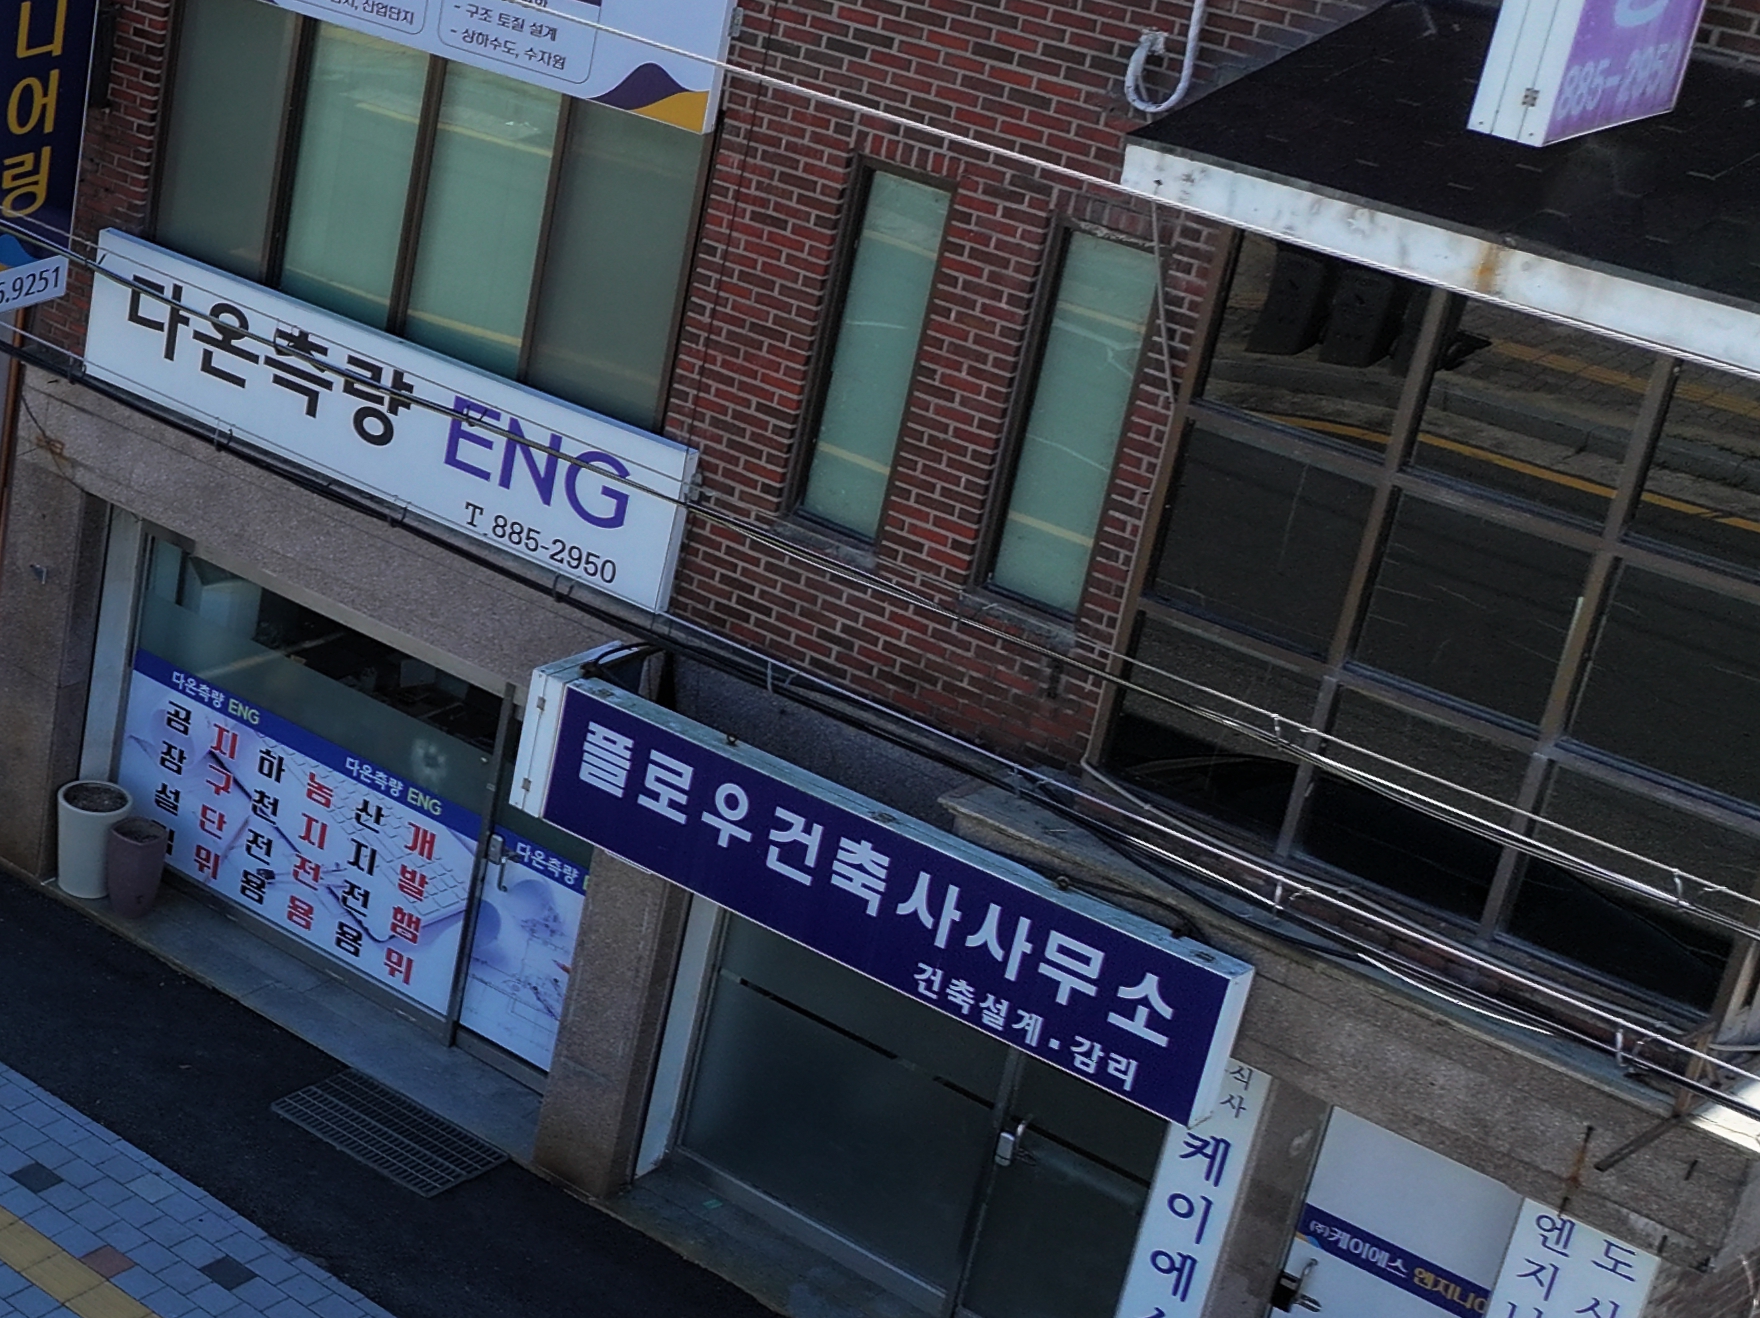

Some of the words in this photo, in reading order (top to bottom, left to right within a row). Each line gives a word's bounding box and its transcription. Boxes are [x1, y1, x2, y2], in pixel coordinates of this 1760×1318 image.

[462, 29, 520, 59] 상하수도,
[523, 45, 567, 71] 수자원
[465, 2, 493, 22] 구조
[497, 12, 525, 33] 토질
[529, 20, 558, 42] 설계
[126, 272, 415, 448] 다온측량
[443, 393, 632, 531] ENG
[172, 670, 226, 710] 다온측량
[227, 699, 261, 727] ENG
[193, 723, 240, 882] 지구단위
[239, 747, 286, 906] 하천전용
[286, 772, 334, 932] 농지전용
[344, 756, 406, 799] 다온측량
[406, 786, 444, 818] ENG
[515, 841, 580, 887] 다온측량
[334, 797, 385, 959] 산지전용
[383, 820, 438, 987] 개발행위
[580, 721, 1177, 1049] 플로우건축사사무소
